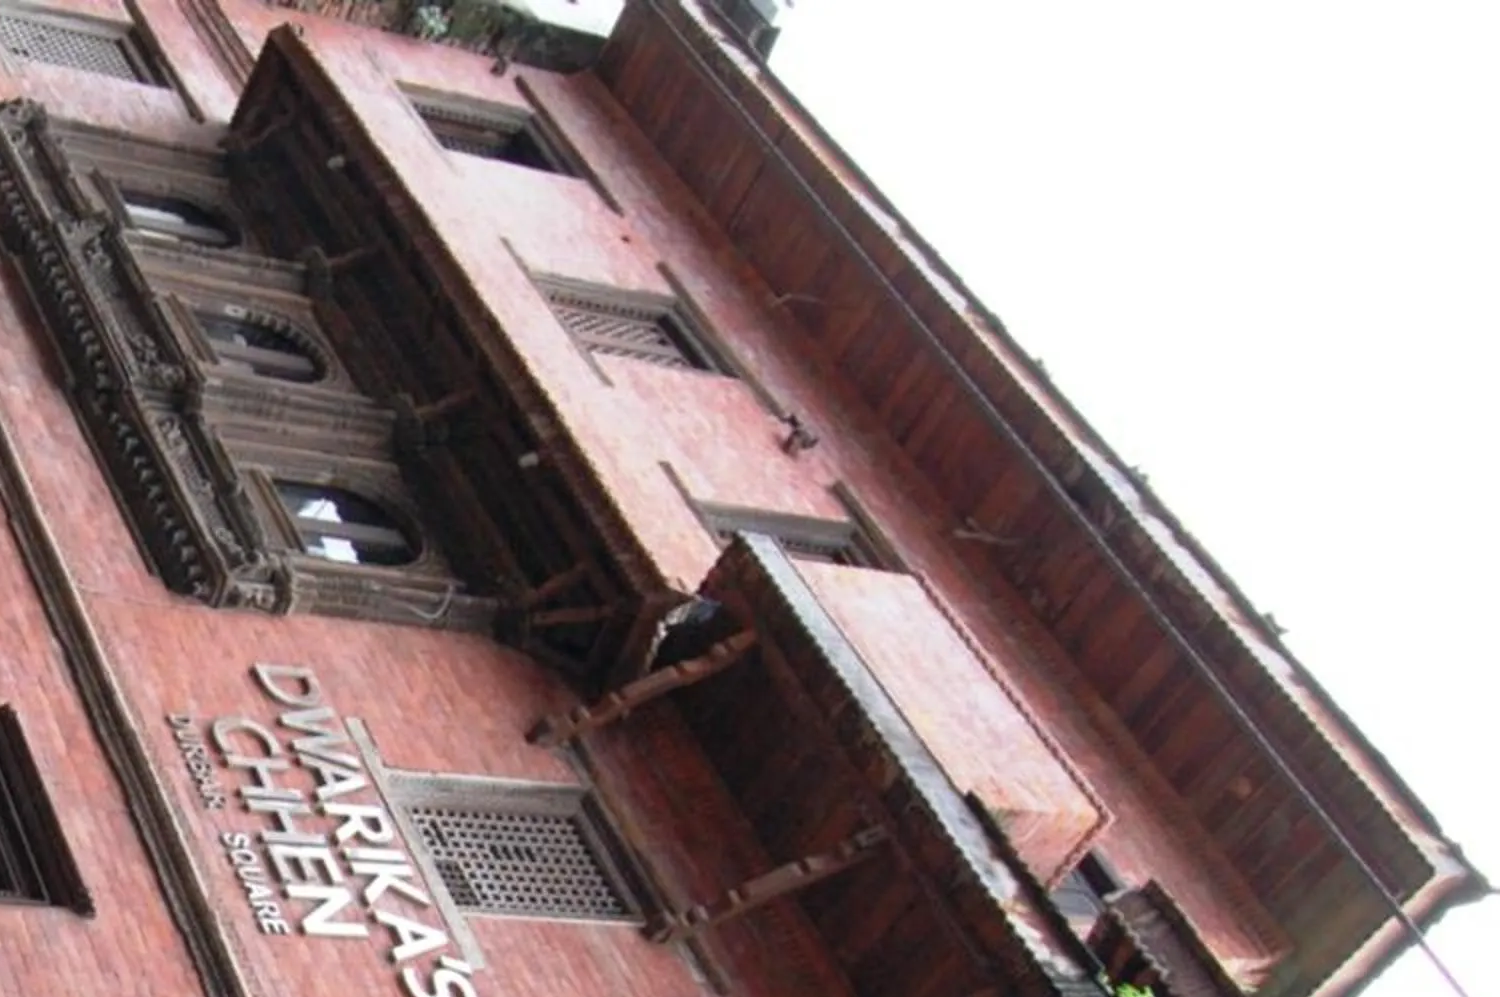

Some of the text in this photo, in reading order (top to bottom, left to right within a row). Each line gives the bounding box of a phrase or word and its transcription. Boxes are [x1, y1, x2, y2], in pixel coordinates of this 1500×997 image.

[167, 711, 290, 937] DURBAR SQUARE
[211, 716, 370, 939] CHHEN
